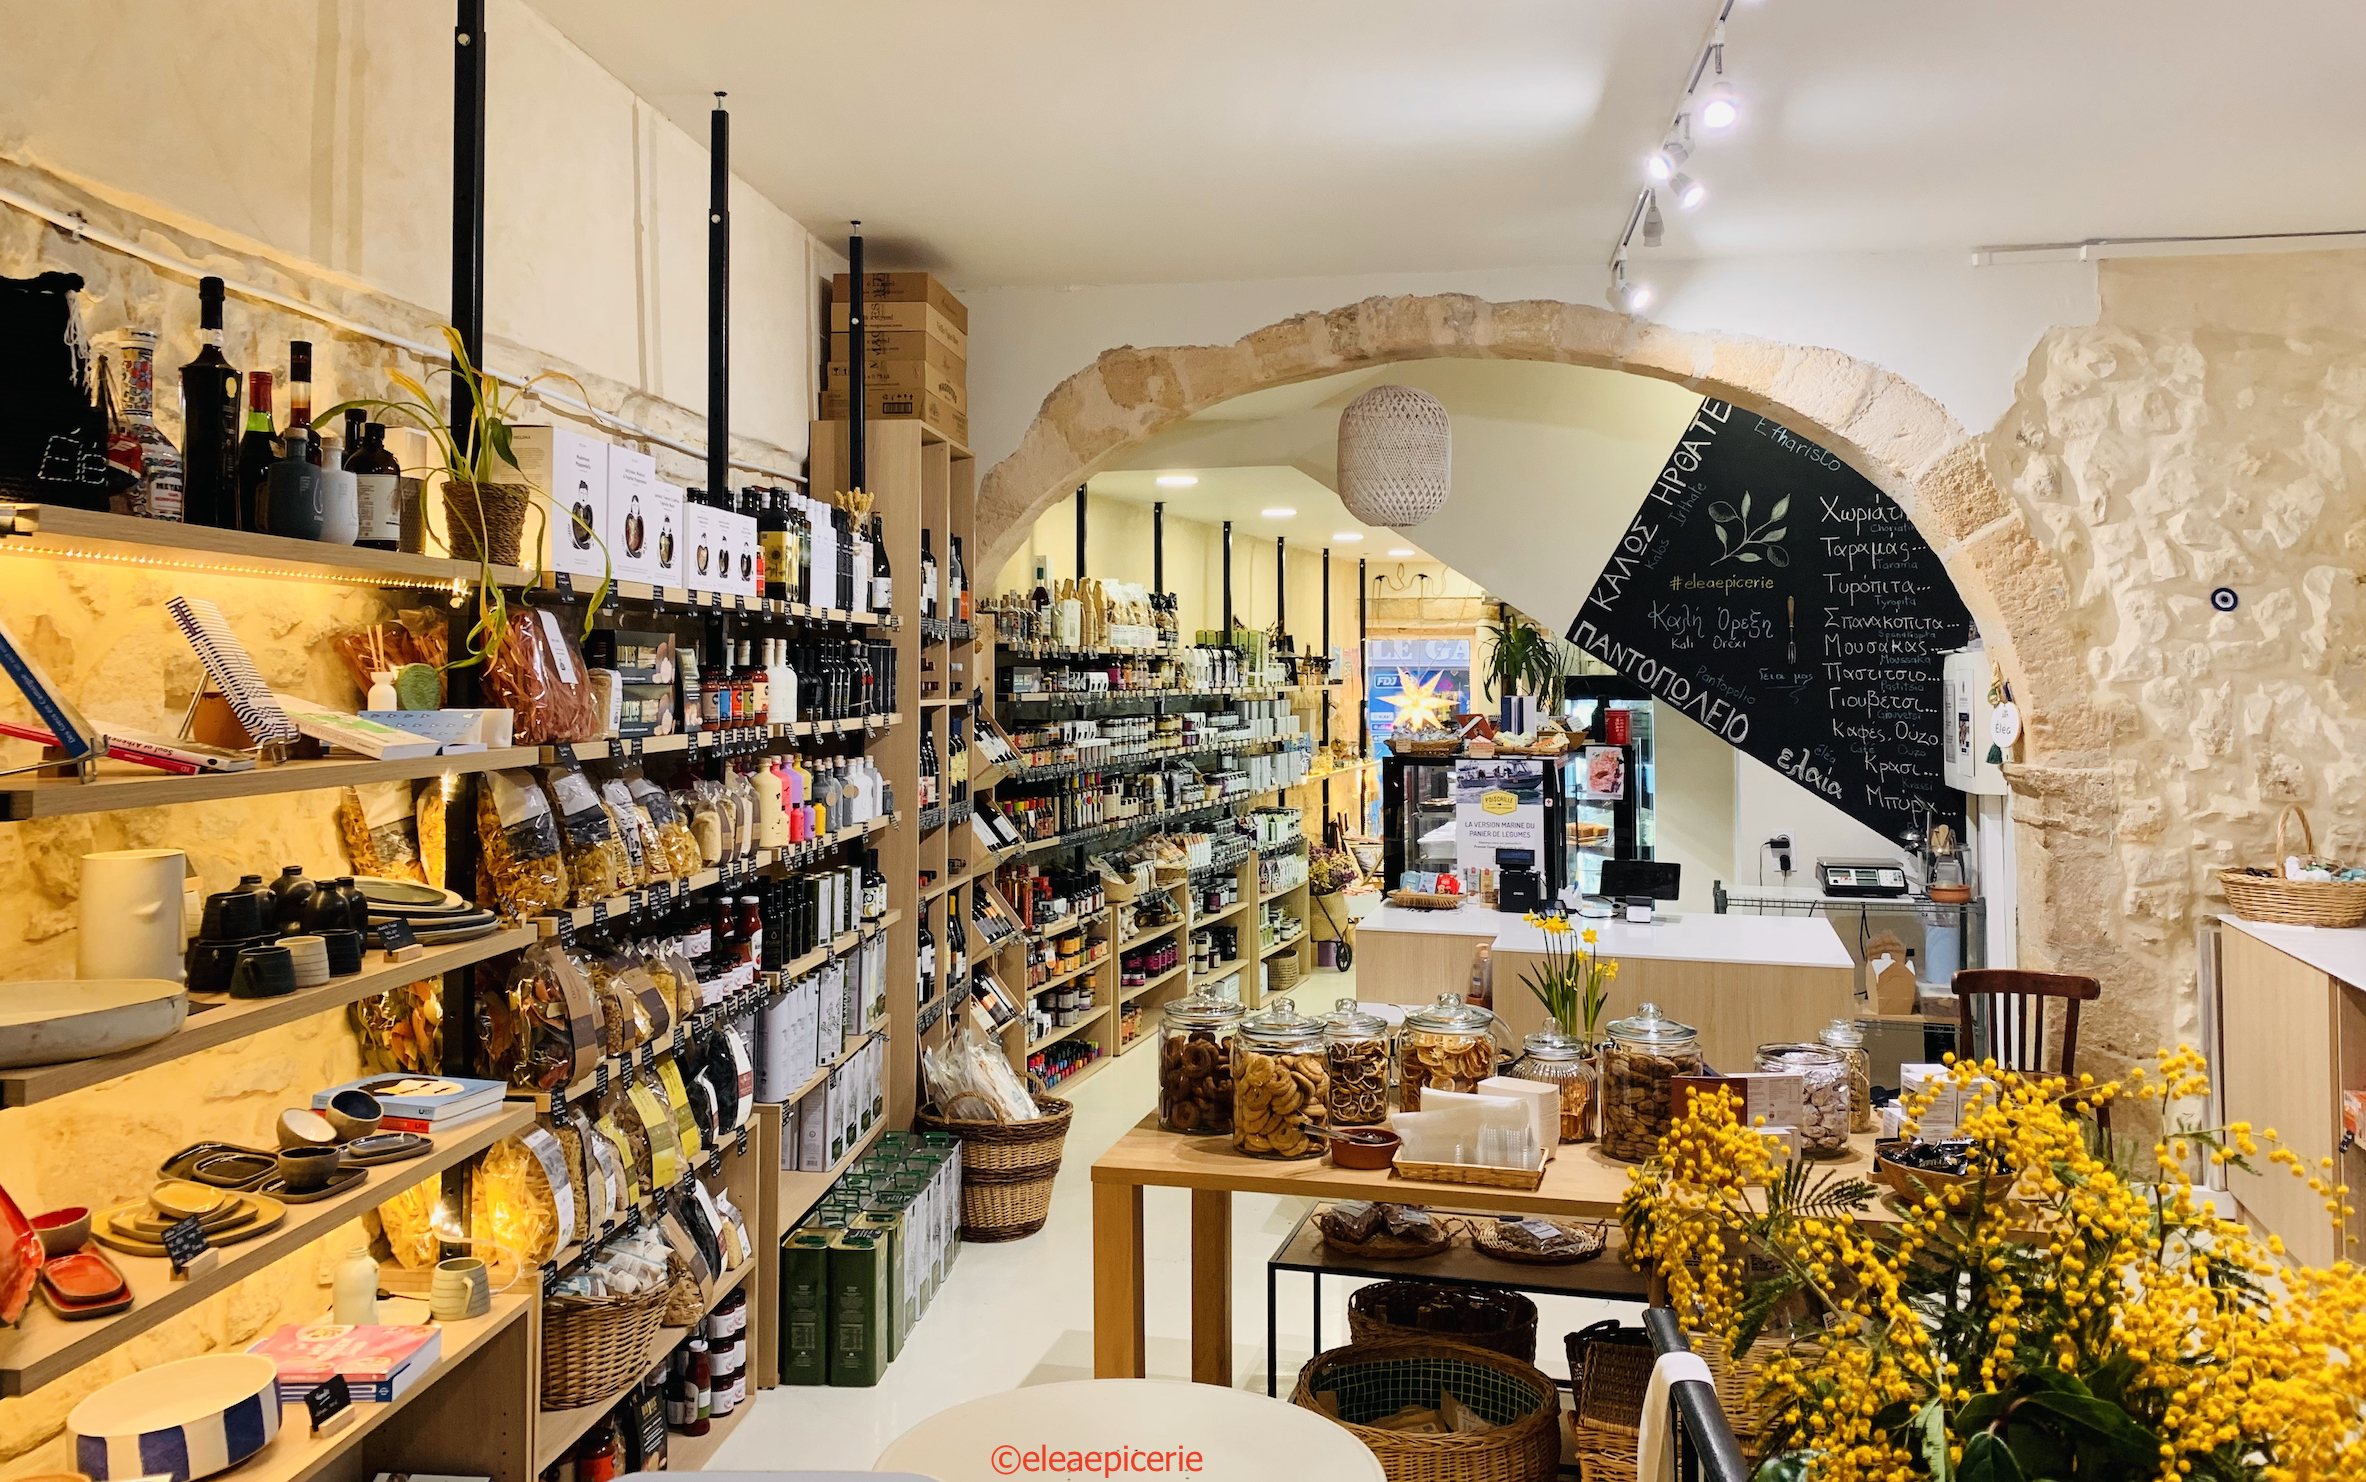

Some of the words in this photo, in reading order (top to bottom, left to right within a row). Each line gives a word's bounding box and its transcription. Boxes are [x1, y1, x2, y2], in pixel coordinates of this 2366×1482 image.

[1651, 397, 1733, 506] ΗΡΘΑΤΕ
[1645, 539, 1671, 570] Kalos
[1667, 482, 1708, 528] Irthate
[1876, 558, 1918, 570] Tarama
[1669, 573, 1775, 597] #eleaepicerie
[1874, 595, 1917, 611] Tyropita
[1647, 600, 1705, 639] Καλή
[1372, 640, 1413, 660] LE
[1671, 635, 1695, 650] Kali
[1881, 654, 1932, 665] Moussaka
[1376, 676, 1398, 686] FDJ
[1695, 664, 1756, 705] Pantopolio
[1880, 679, 1925, 692] Pastitsio
[153, 745, 175, 757] Soul
[1897, 744, 1927, 758] Ouzo
[1901, 776, 1934, 792] Krassi
[1474, 821, 1500, 829] VERSION
